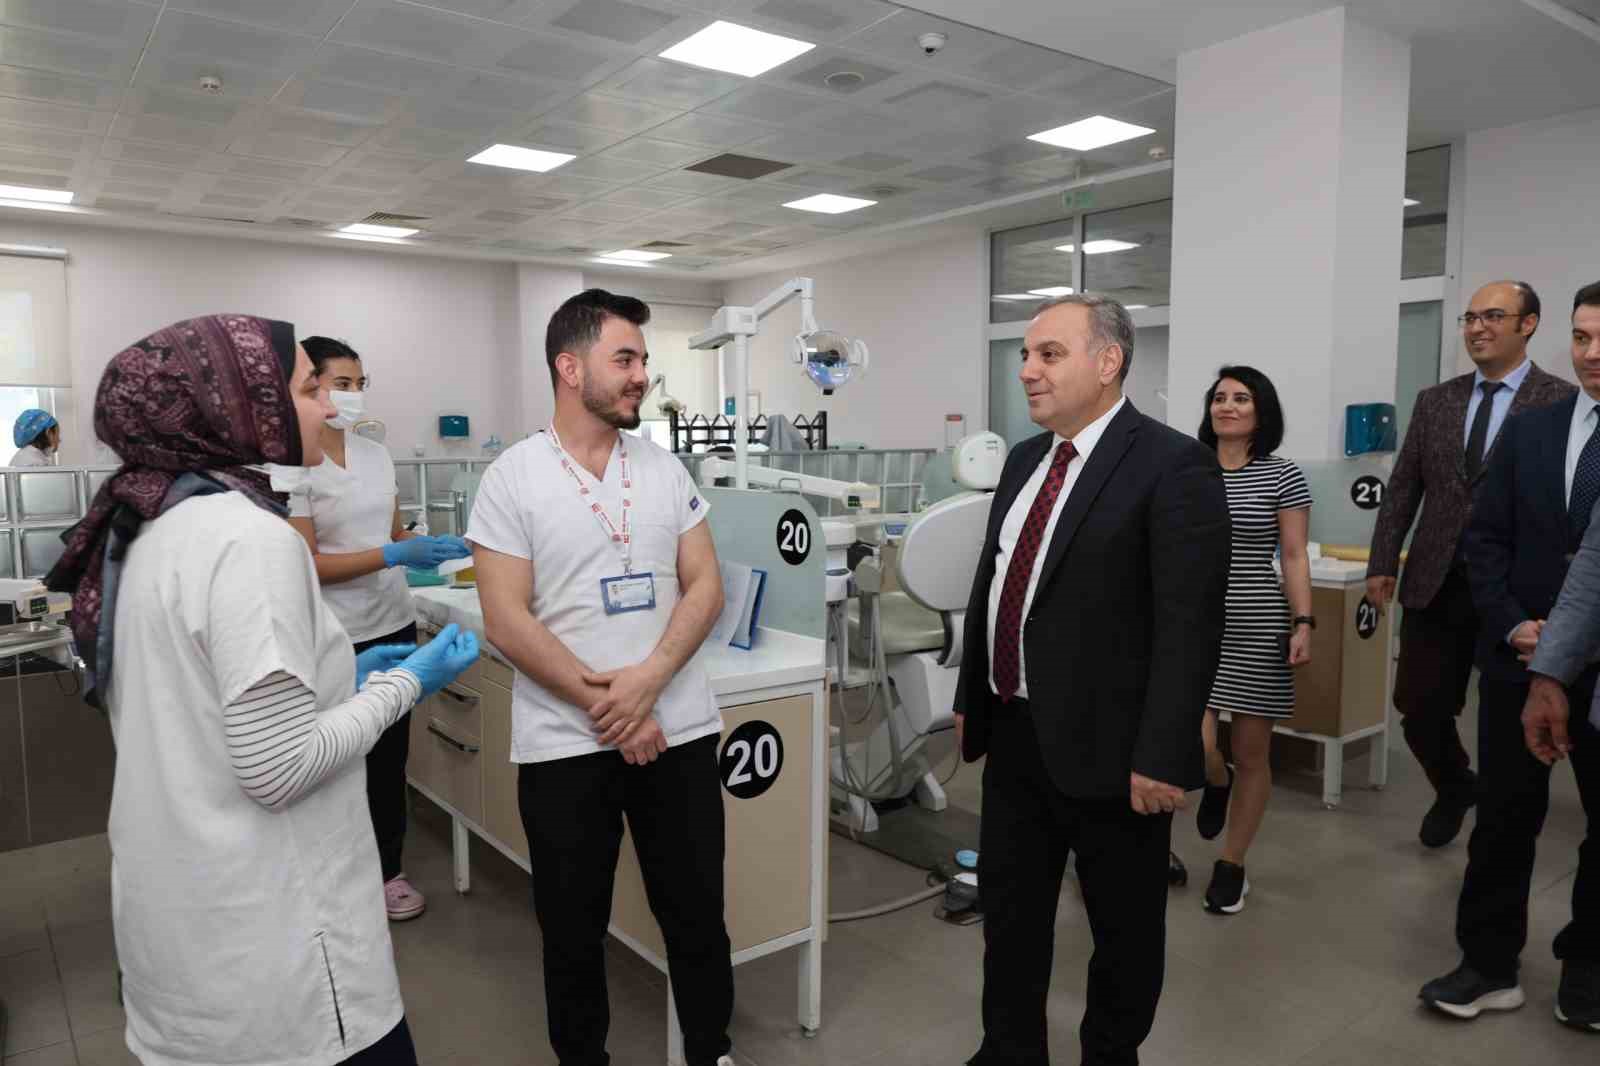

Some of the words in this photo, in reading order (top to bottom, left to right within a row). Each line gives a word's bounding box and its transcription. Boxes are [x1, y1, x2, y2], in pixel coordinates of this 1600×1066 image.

[1355, 482, 1382, 503] 21
[781, 520, 808, 554] 20
[1359, 603, 1376, 631] 21
[726, 733, 778, 787] 20
